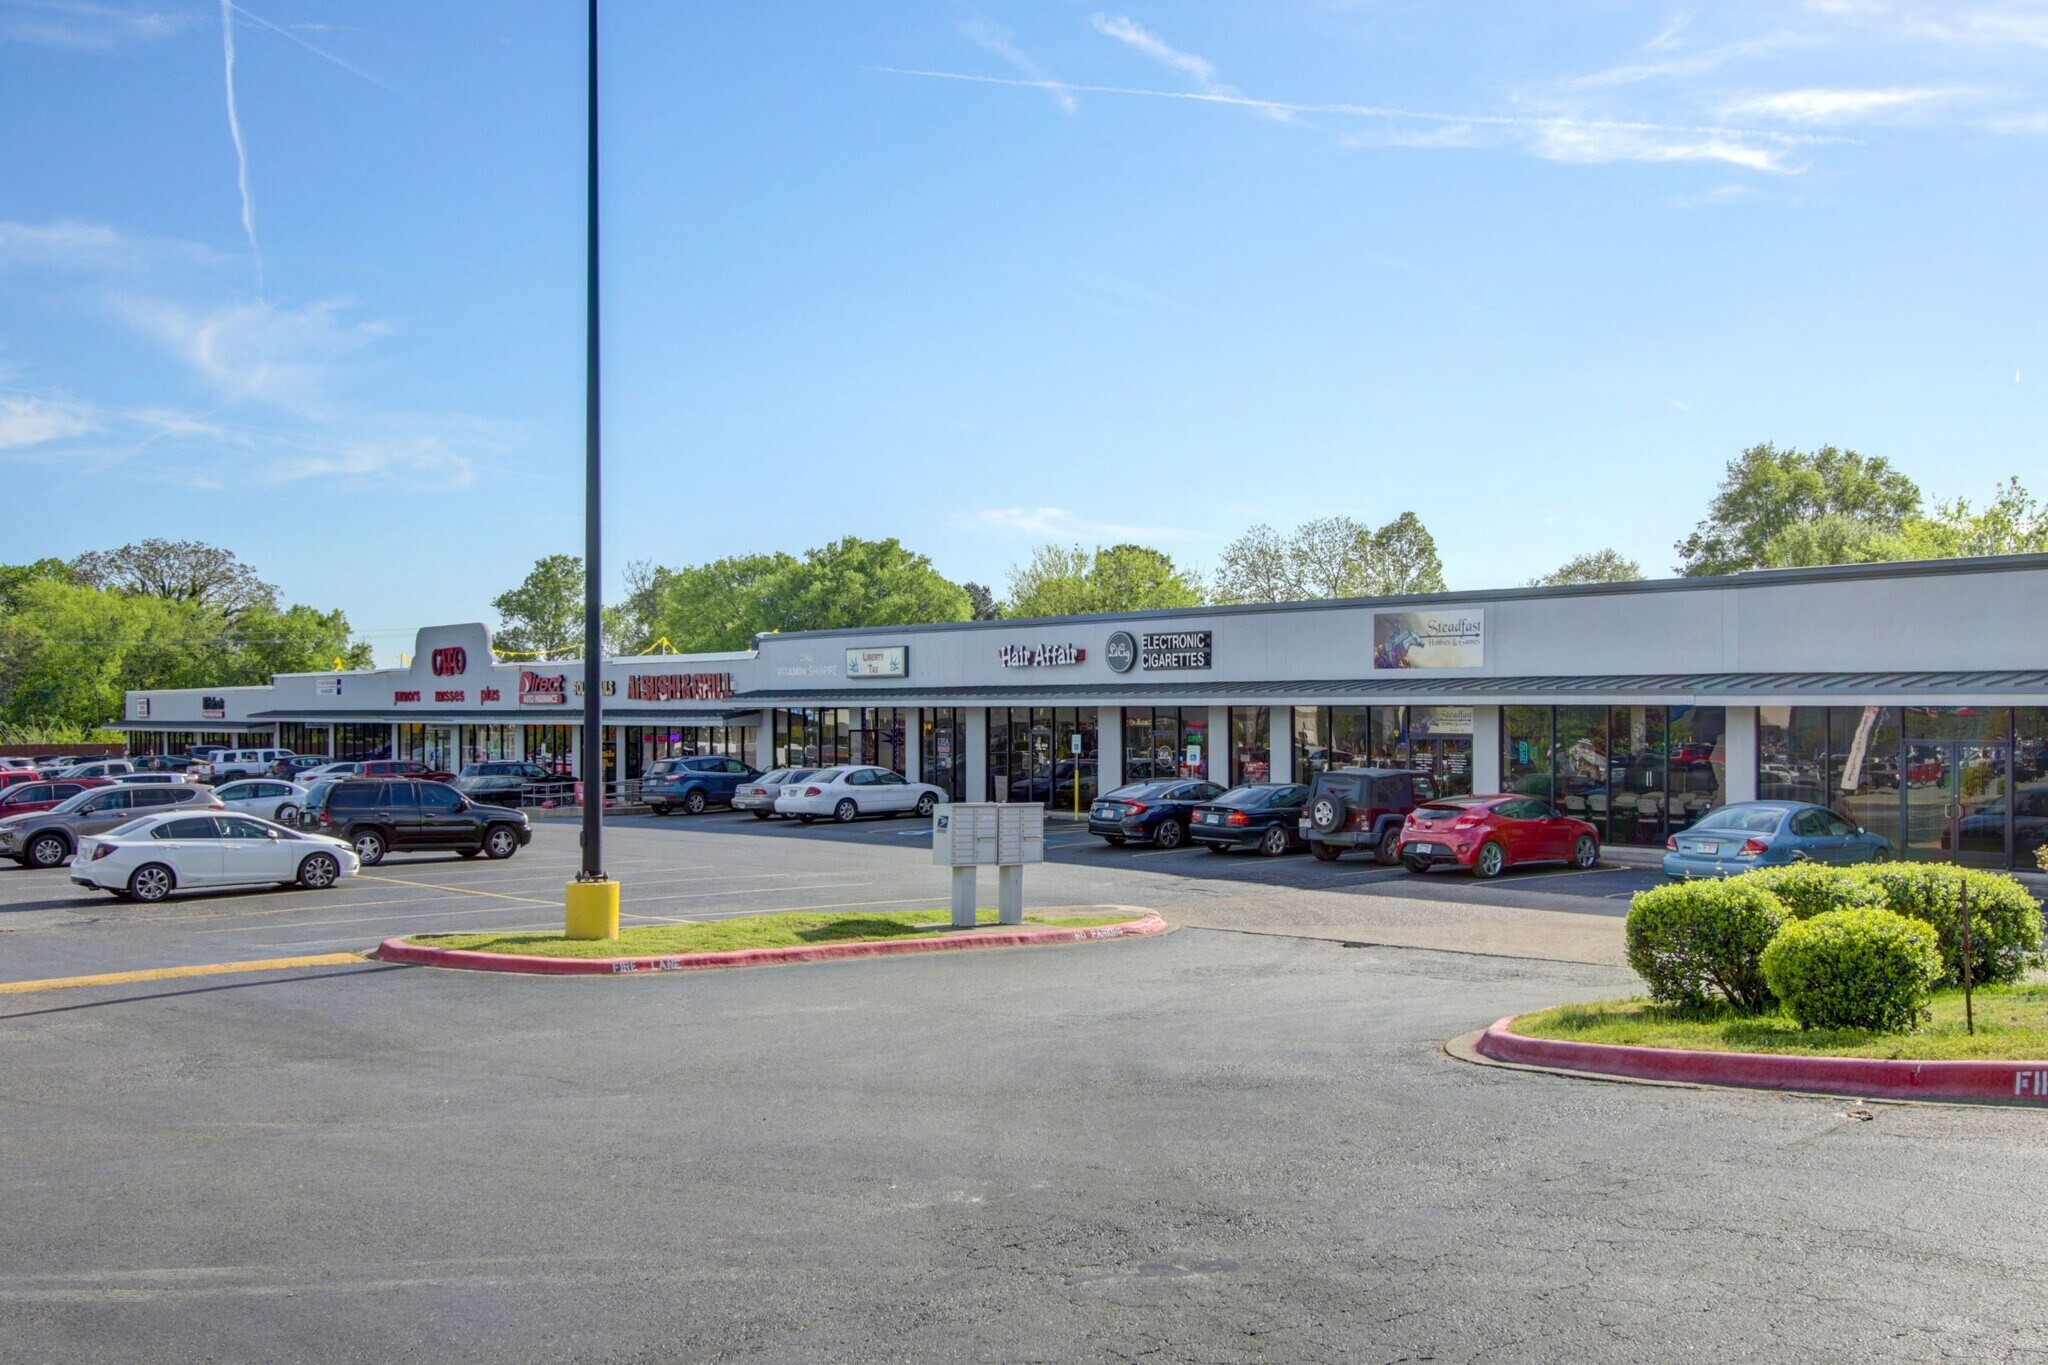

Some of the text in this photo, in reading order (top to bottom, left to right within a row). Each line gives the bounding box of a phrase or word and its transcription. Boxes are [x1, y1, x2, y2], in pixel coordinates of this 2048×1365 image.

[1427, 618, 1481, 638] Steadfast
[1142, 633, 1204, 650] ELECTRONIC
[1428, 638, 1451, 646] Hobbies
[1458, 638, 1480, 646] Games
[432, 646, 466, 676] CATO
[1000, 643, 1078, 668] Hair Affair
[1142, 651, 1205, 668] CIGARETTES
[520, 671, 565, 693] Direct
[641, 673, 681, 701] SUSHI
[681, 674, 691, 700] &
[692, 672, 733, 700] GRILL
[394, 686, 501, 706] juniors misses plus
[613, 959, 682, 972] FIRE LANE
